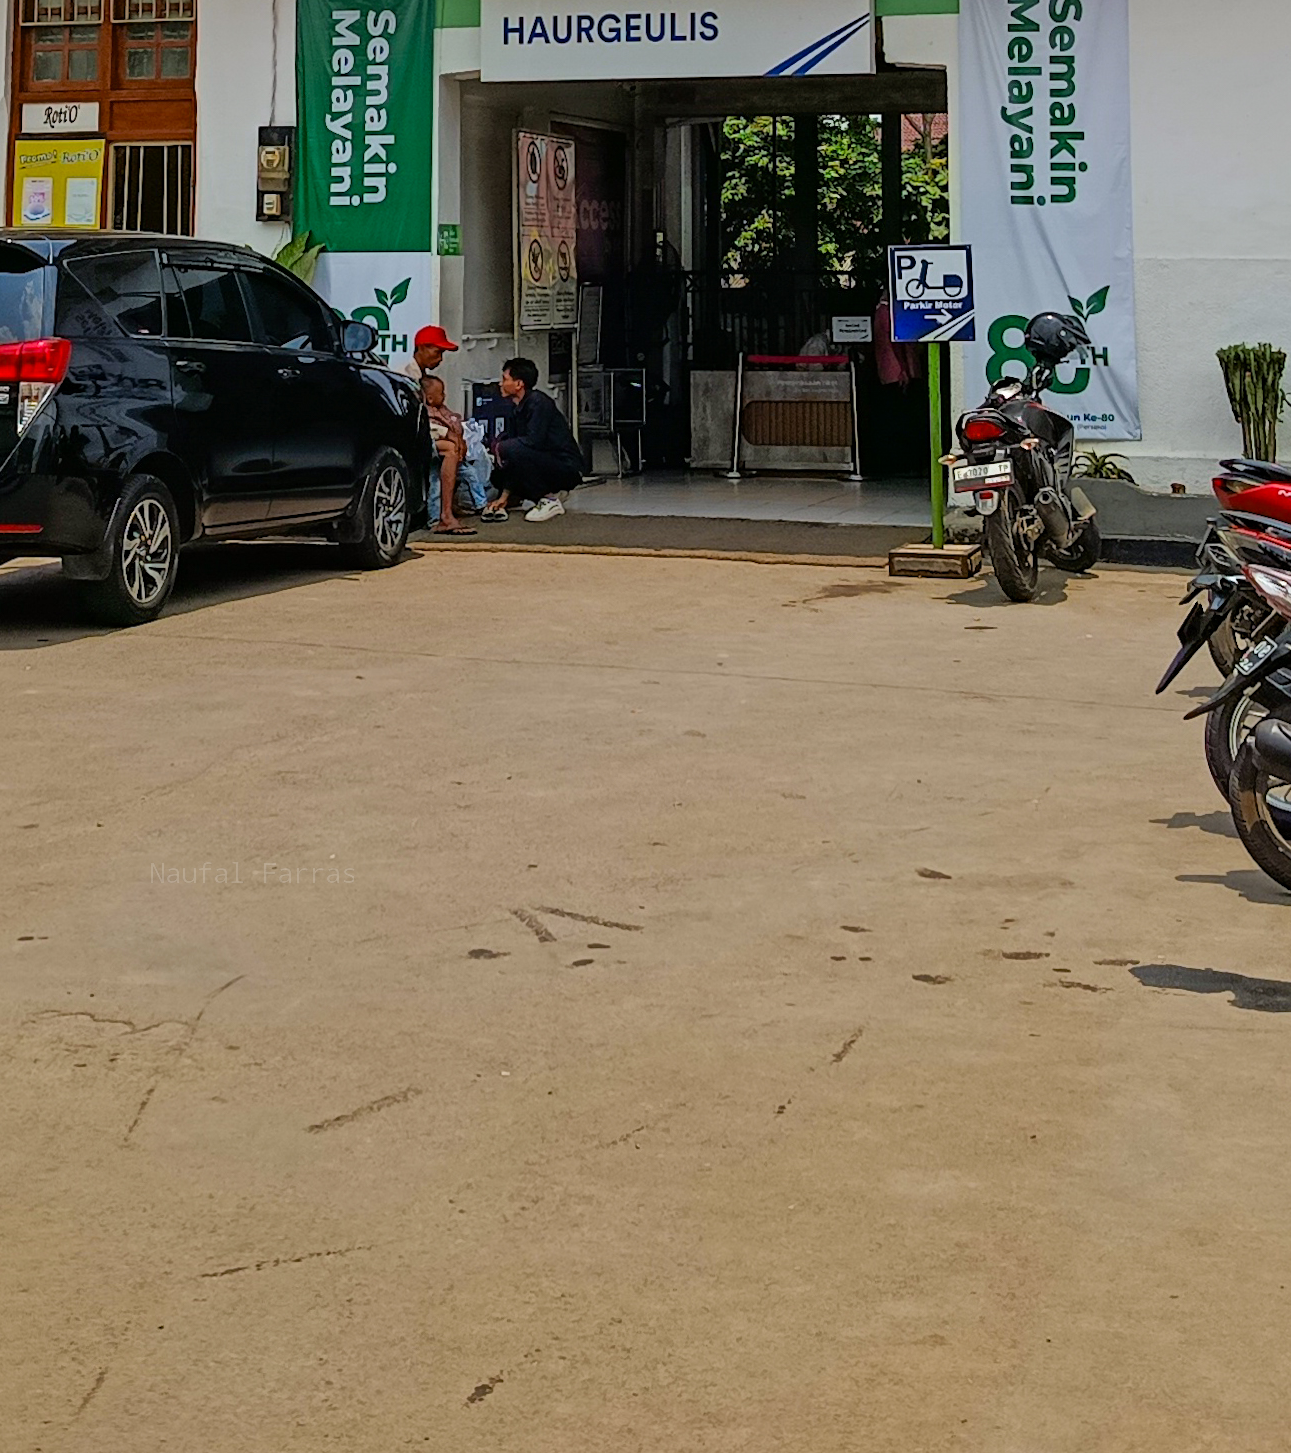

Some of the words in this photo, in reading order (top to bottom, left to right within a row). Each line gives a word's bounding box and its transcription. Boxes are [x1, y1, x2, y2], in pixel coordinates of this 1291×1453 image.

[503, 11, 719, 45] HAURGEULIS
[325, 9, 361, 207] Melayani
[362, 9, 397, 204] Semakin
[896, 255, 916, 279] P
[903, 301, 933, 310] Parkir
[934, 300, 963, 309] Motor
[1083, 413, 1115, 422] Ke-80
